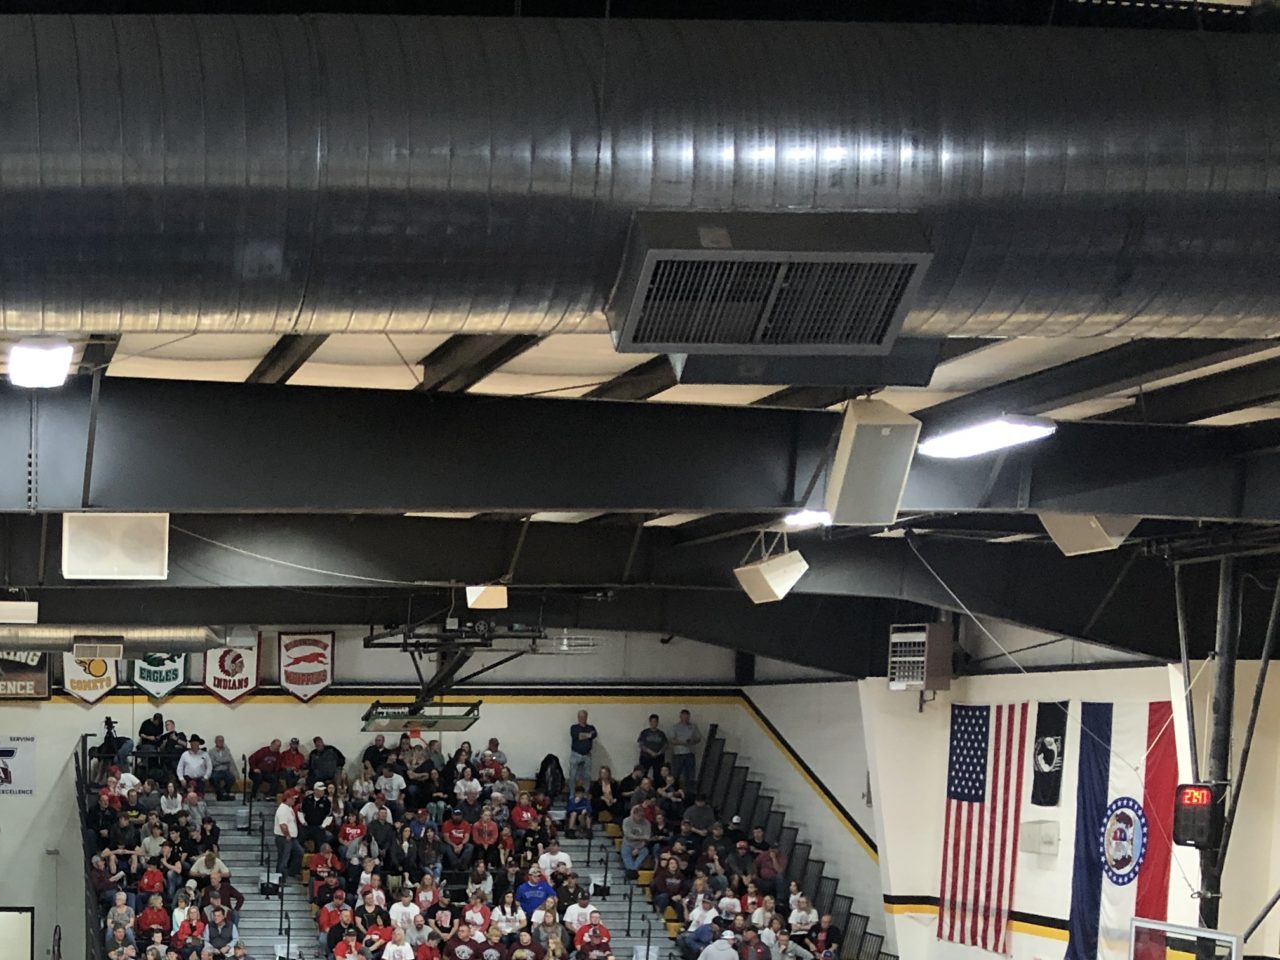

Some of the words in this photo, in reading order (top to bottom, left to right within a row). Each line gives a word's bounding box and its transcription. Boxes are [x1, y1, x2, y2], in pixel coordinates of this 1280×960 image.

[139, 668, 179, 683] EAGLES
[213, 676, 249, 690] INDIANS
[70, 676, 112, 691] COMETS
